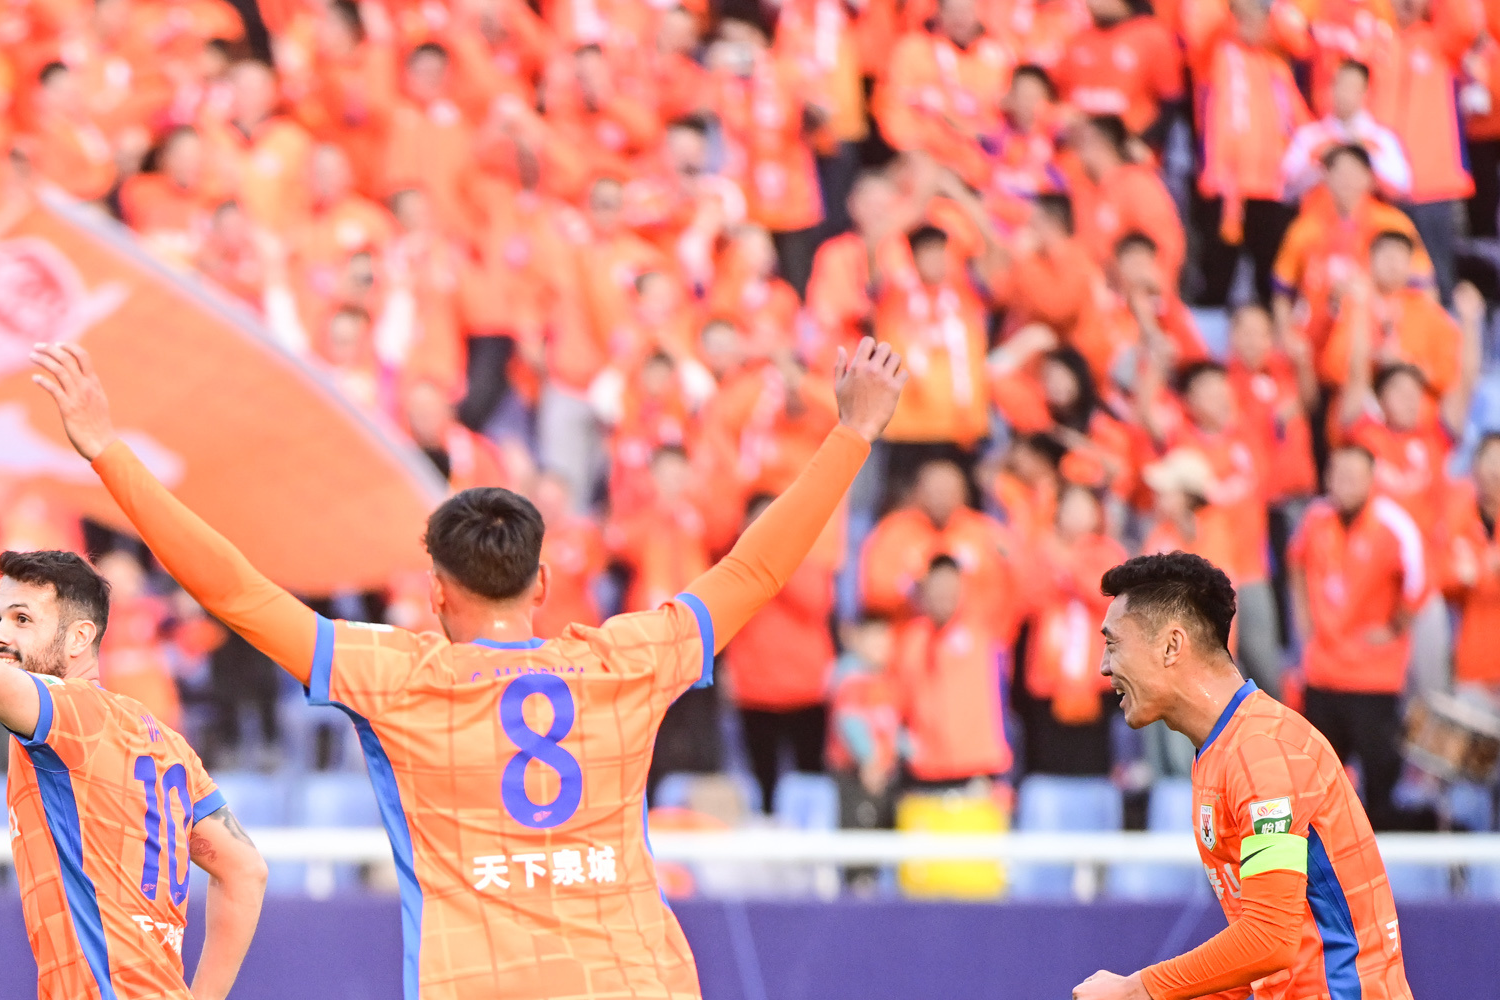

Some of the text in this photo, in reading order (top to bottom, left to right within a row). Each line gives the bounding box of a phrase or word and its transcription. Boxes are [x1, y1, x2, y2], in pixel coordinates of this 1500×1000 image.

[500, 673, 583, 829] 8
[133, 755, 194, 907] 10
[473, 846, 617, 890] 天下泉城
